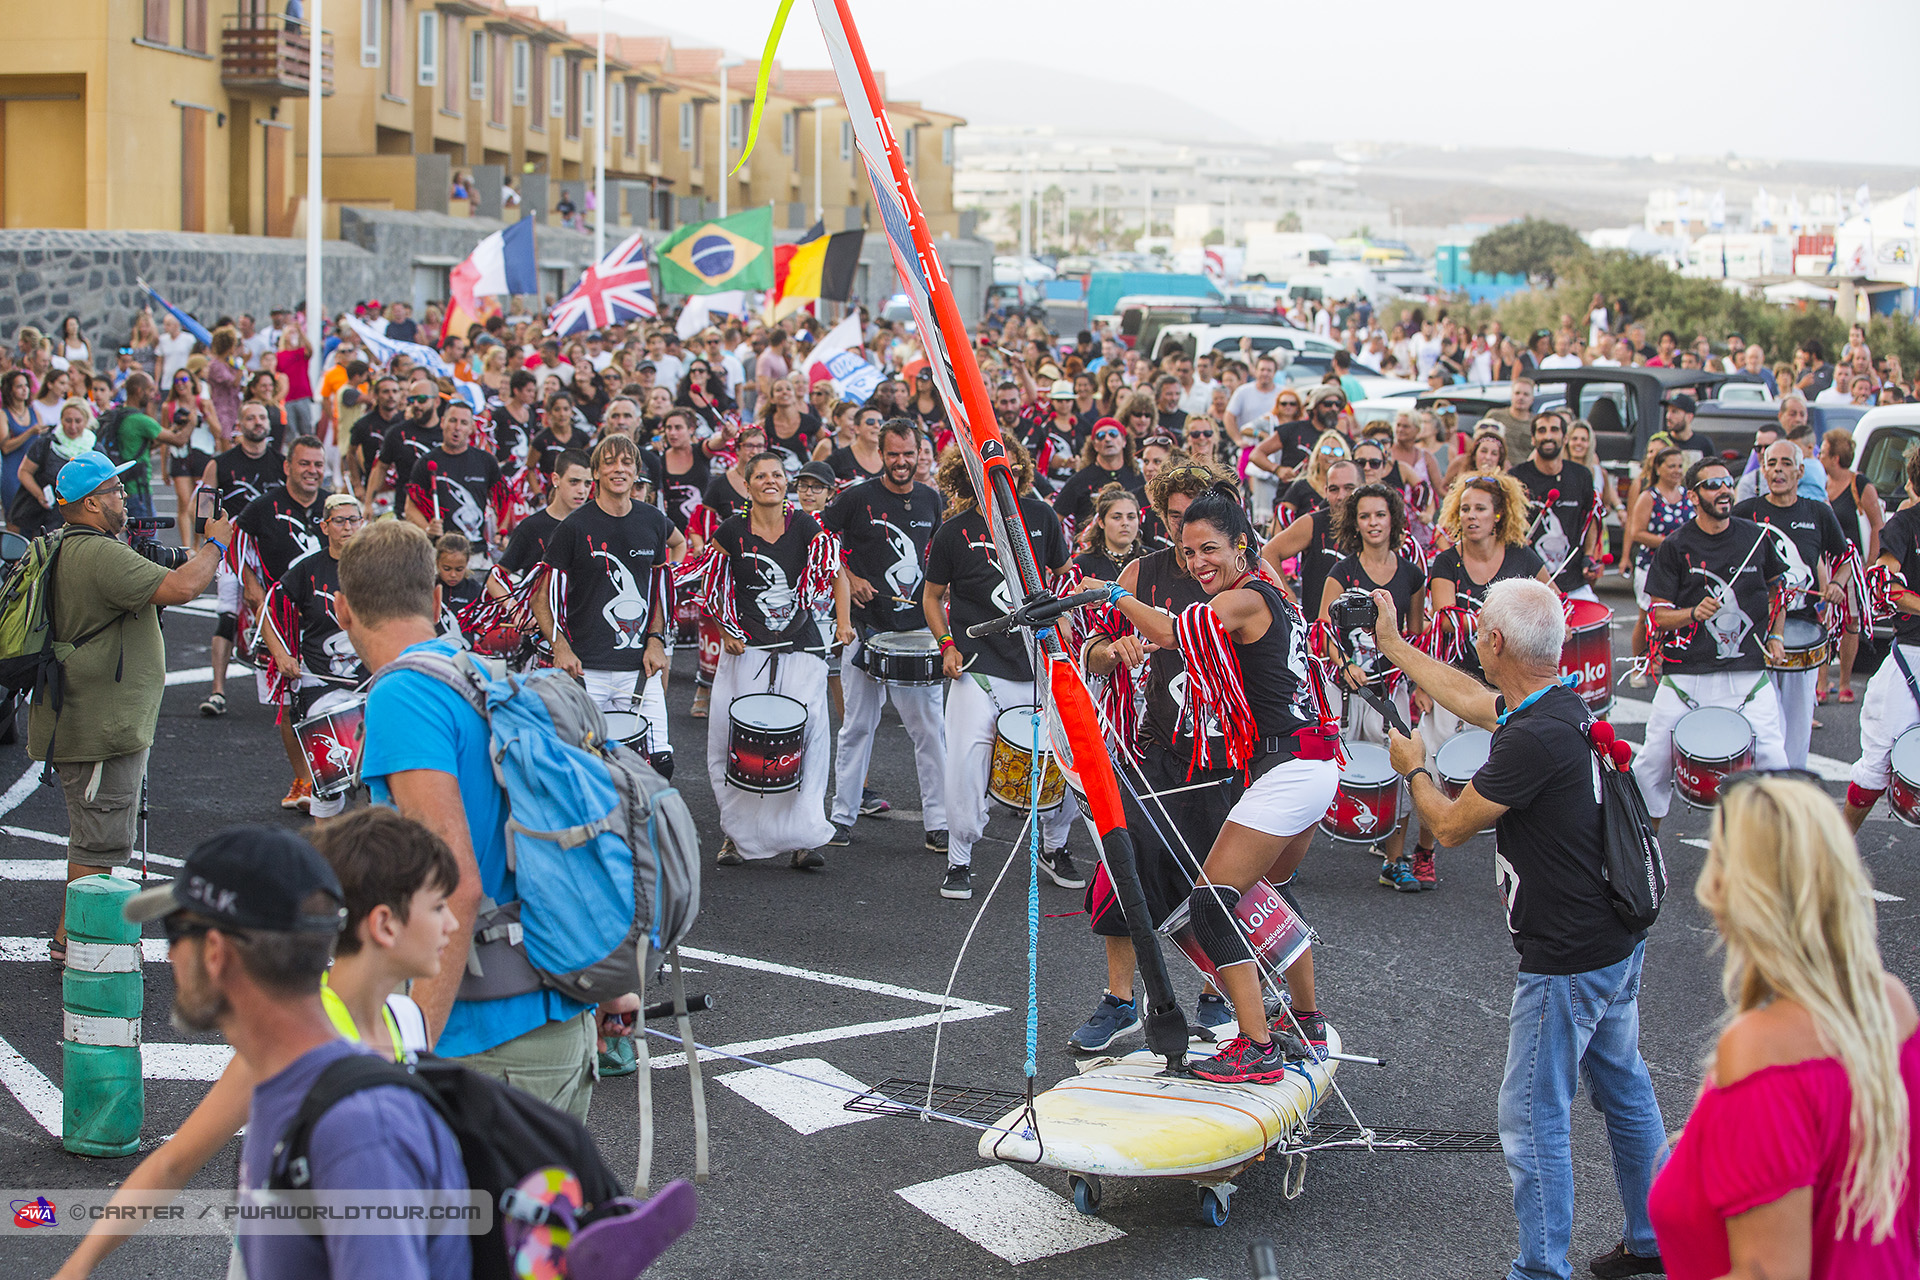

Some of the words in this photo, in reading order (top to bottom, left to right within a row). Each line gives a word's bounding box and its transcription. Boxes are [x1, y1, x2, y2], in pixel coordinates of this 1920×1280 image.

[1561, 661, 1606, 685] loko
[1237, 895, 1280, 935] loko
[1254, 914, 1293, 955] okodelvalle.com
